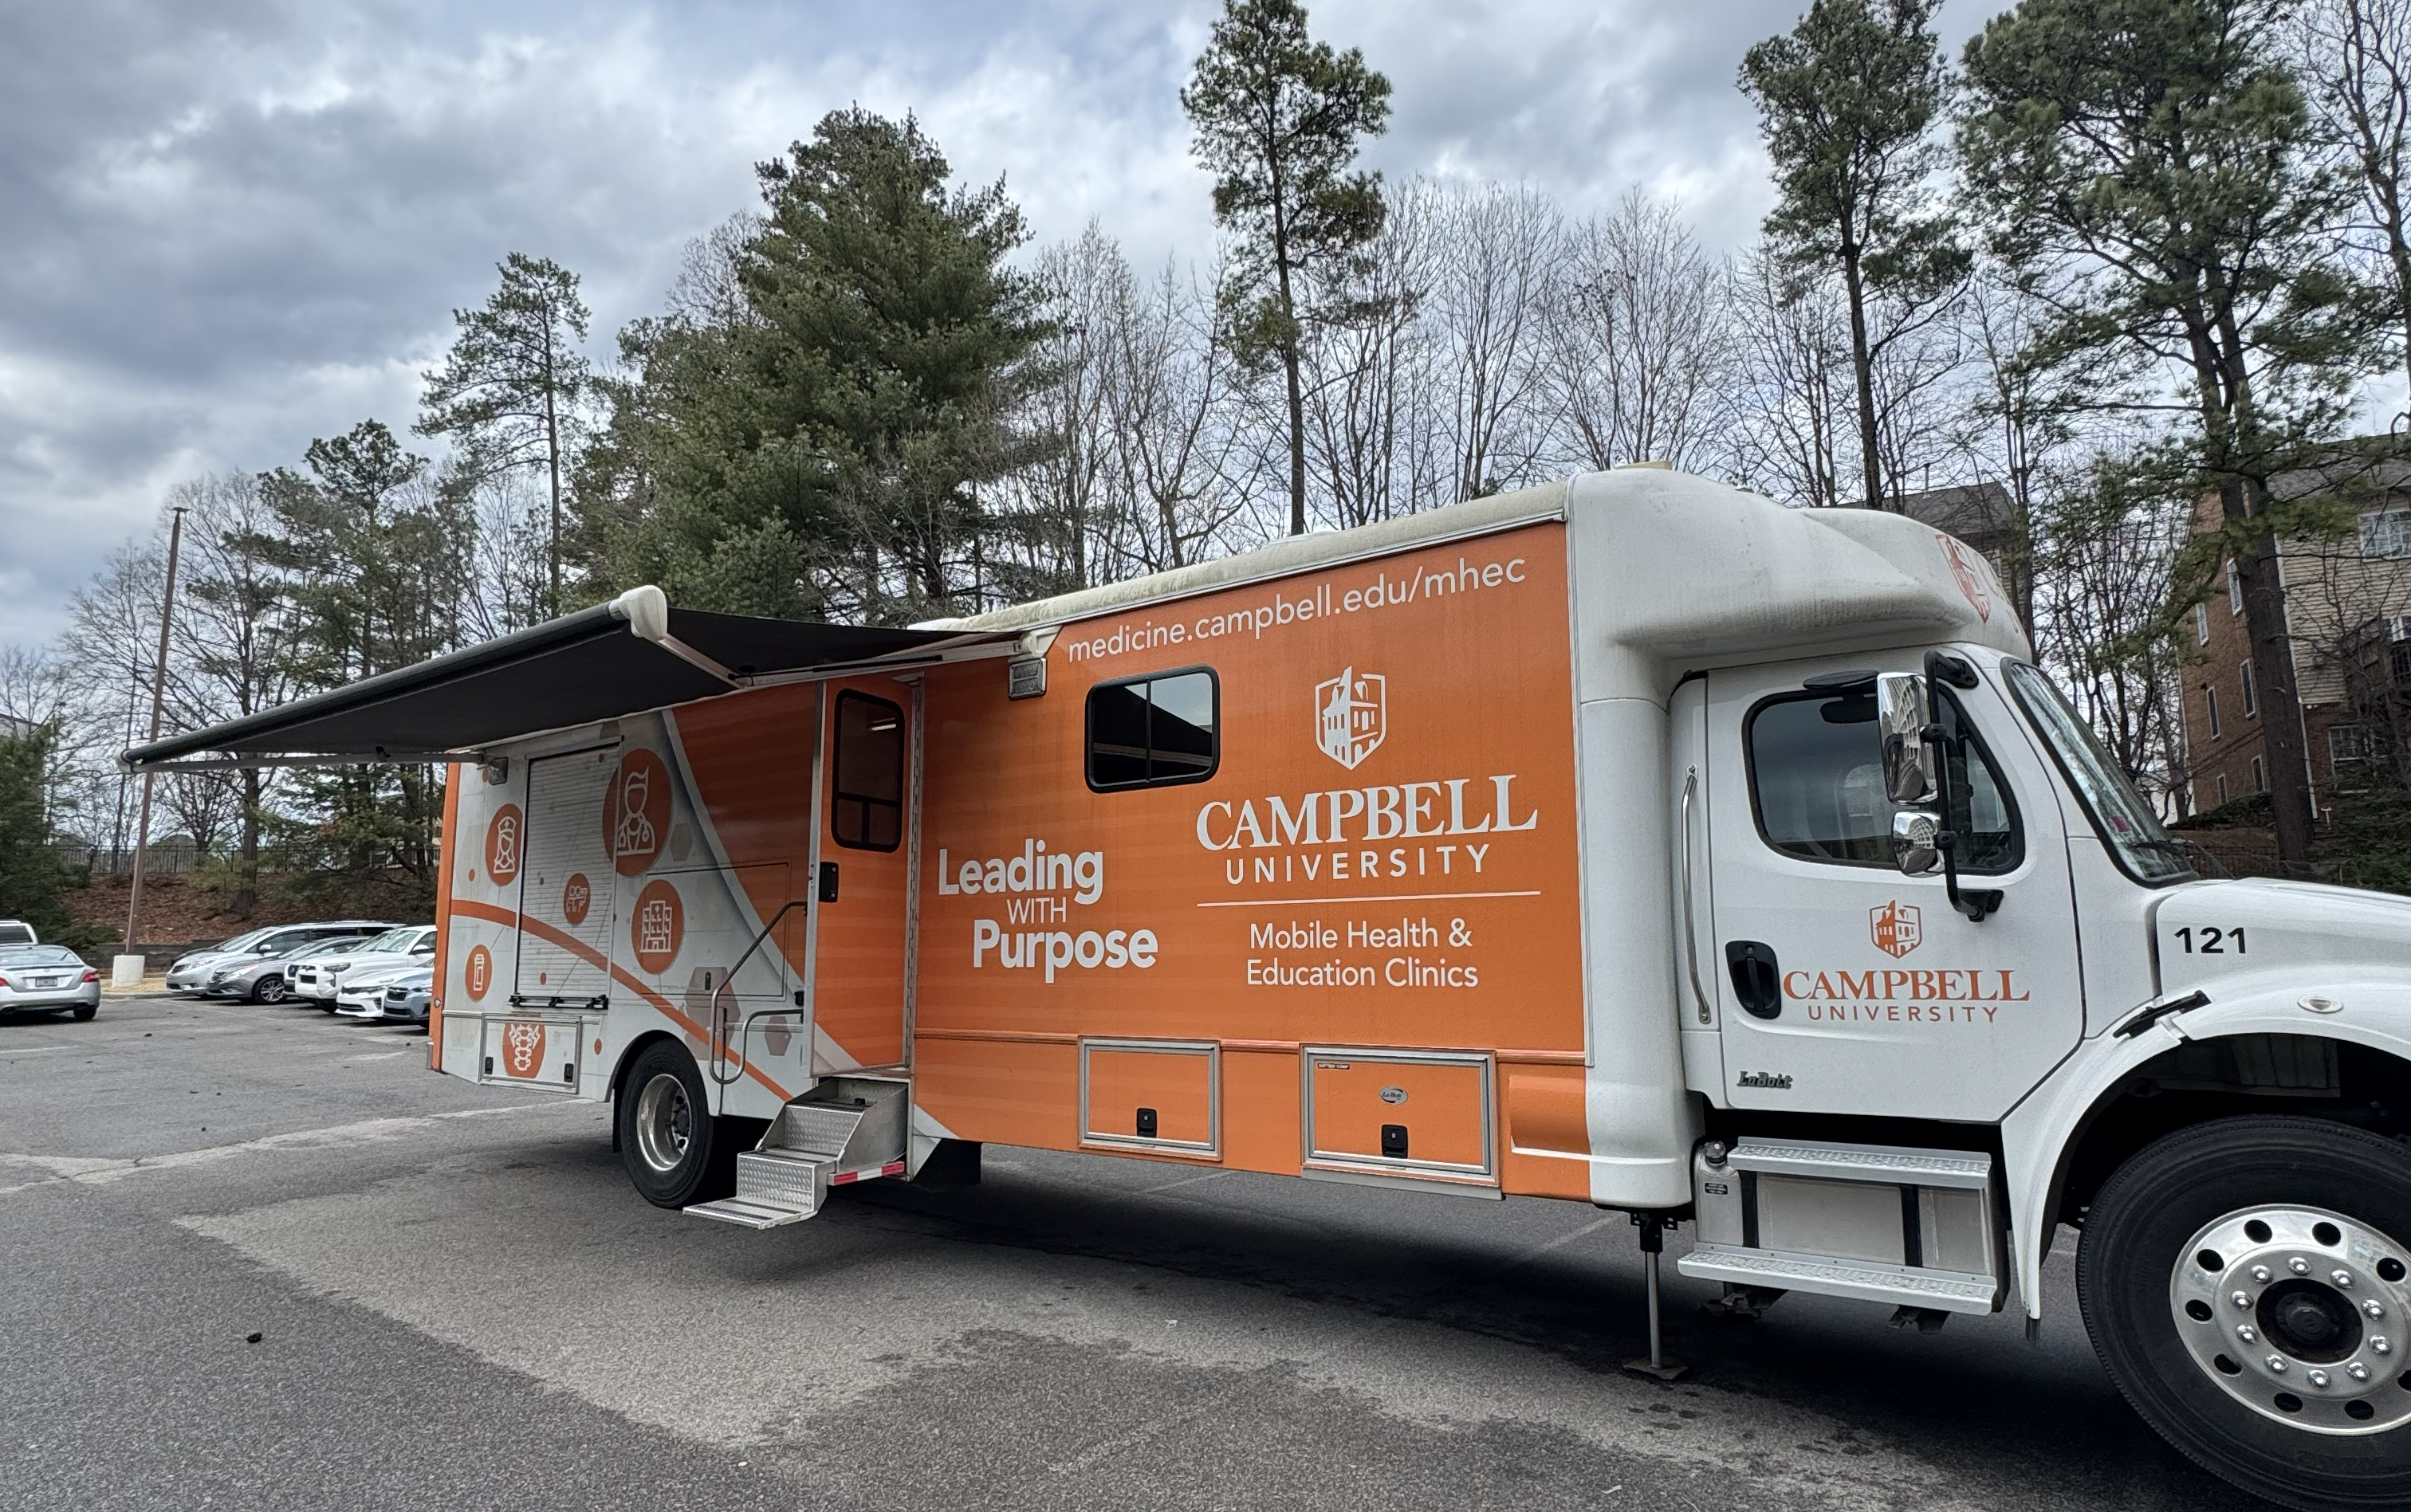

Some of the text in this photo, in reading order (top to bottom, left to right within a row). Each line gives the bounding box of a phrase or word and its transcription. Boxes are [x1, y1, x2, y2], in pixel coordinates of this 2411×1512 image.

[1068, 556, 1526, 662] medicine.campbell.edu/mhec
[1196, 774, 1538, 851] CAMPBELL
[938, 838, 1103, 905] Leading
[1225, 843, 1490, 885] UNIVERSITY
[1006, 896, 1067, 925] WITH
[1249, 917, 1473, 949] Mobile Health &
[2173, 927, 2247, 955] 121
[973, 918, 1158, 984] Purpose
[1246, 956, 1479, 988] Education Clinics
[1783, 969, 2031, 1002] CAMPBELL
[1807, 1005, 1998, 1023] UNIVERSITY
